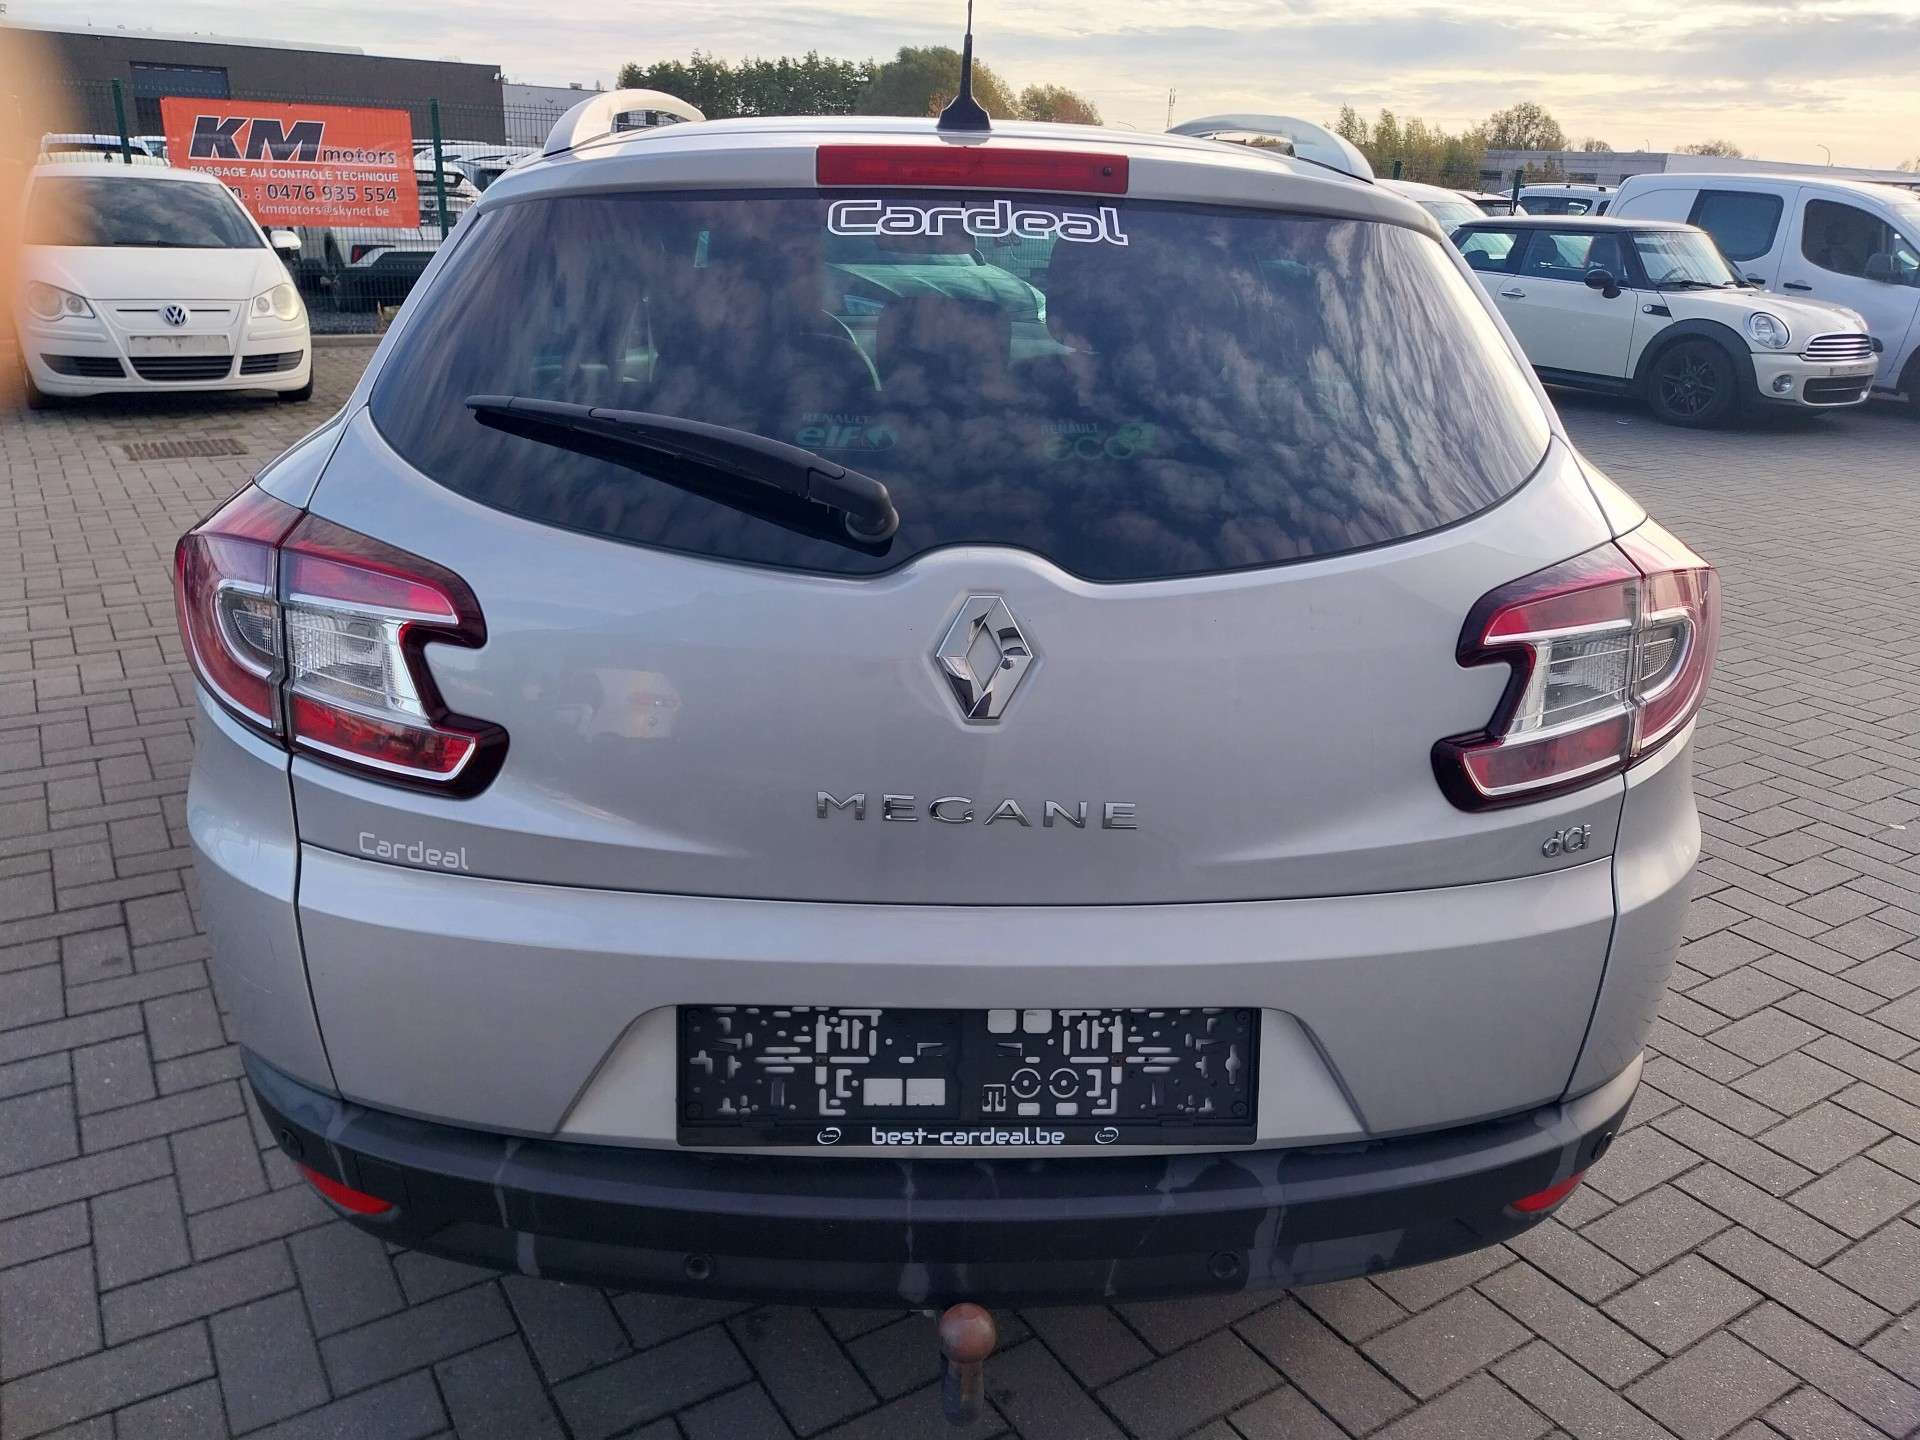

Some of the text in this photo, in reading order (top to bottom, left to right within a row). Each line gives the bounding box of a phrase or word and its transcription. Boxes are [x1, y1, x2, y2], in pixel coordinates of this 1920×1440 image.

[189, 115, 396, 165] KM motors
[190, 165, 399, 183] PASSAGE AU CONTRÔLE TECHNIQUE
[258, 203, 390, 217] kmmotors@skynet.be
[267, 183, 315, 201] 0476
[322, 185, 356, 201] 935
[363, 186, 398, 203] 554
[827, 200, 1129, 246] Cardeal
[816, 790, 1139, 830] MEGANE
[359, 831, 469, 871] Cardeal
[1541, 823, 1592, 858] dCi
[871, 1127, 1065, 1145] best-cardeal.be
